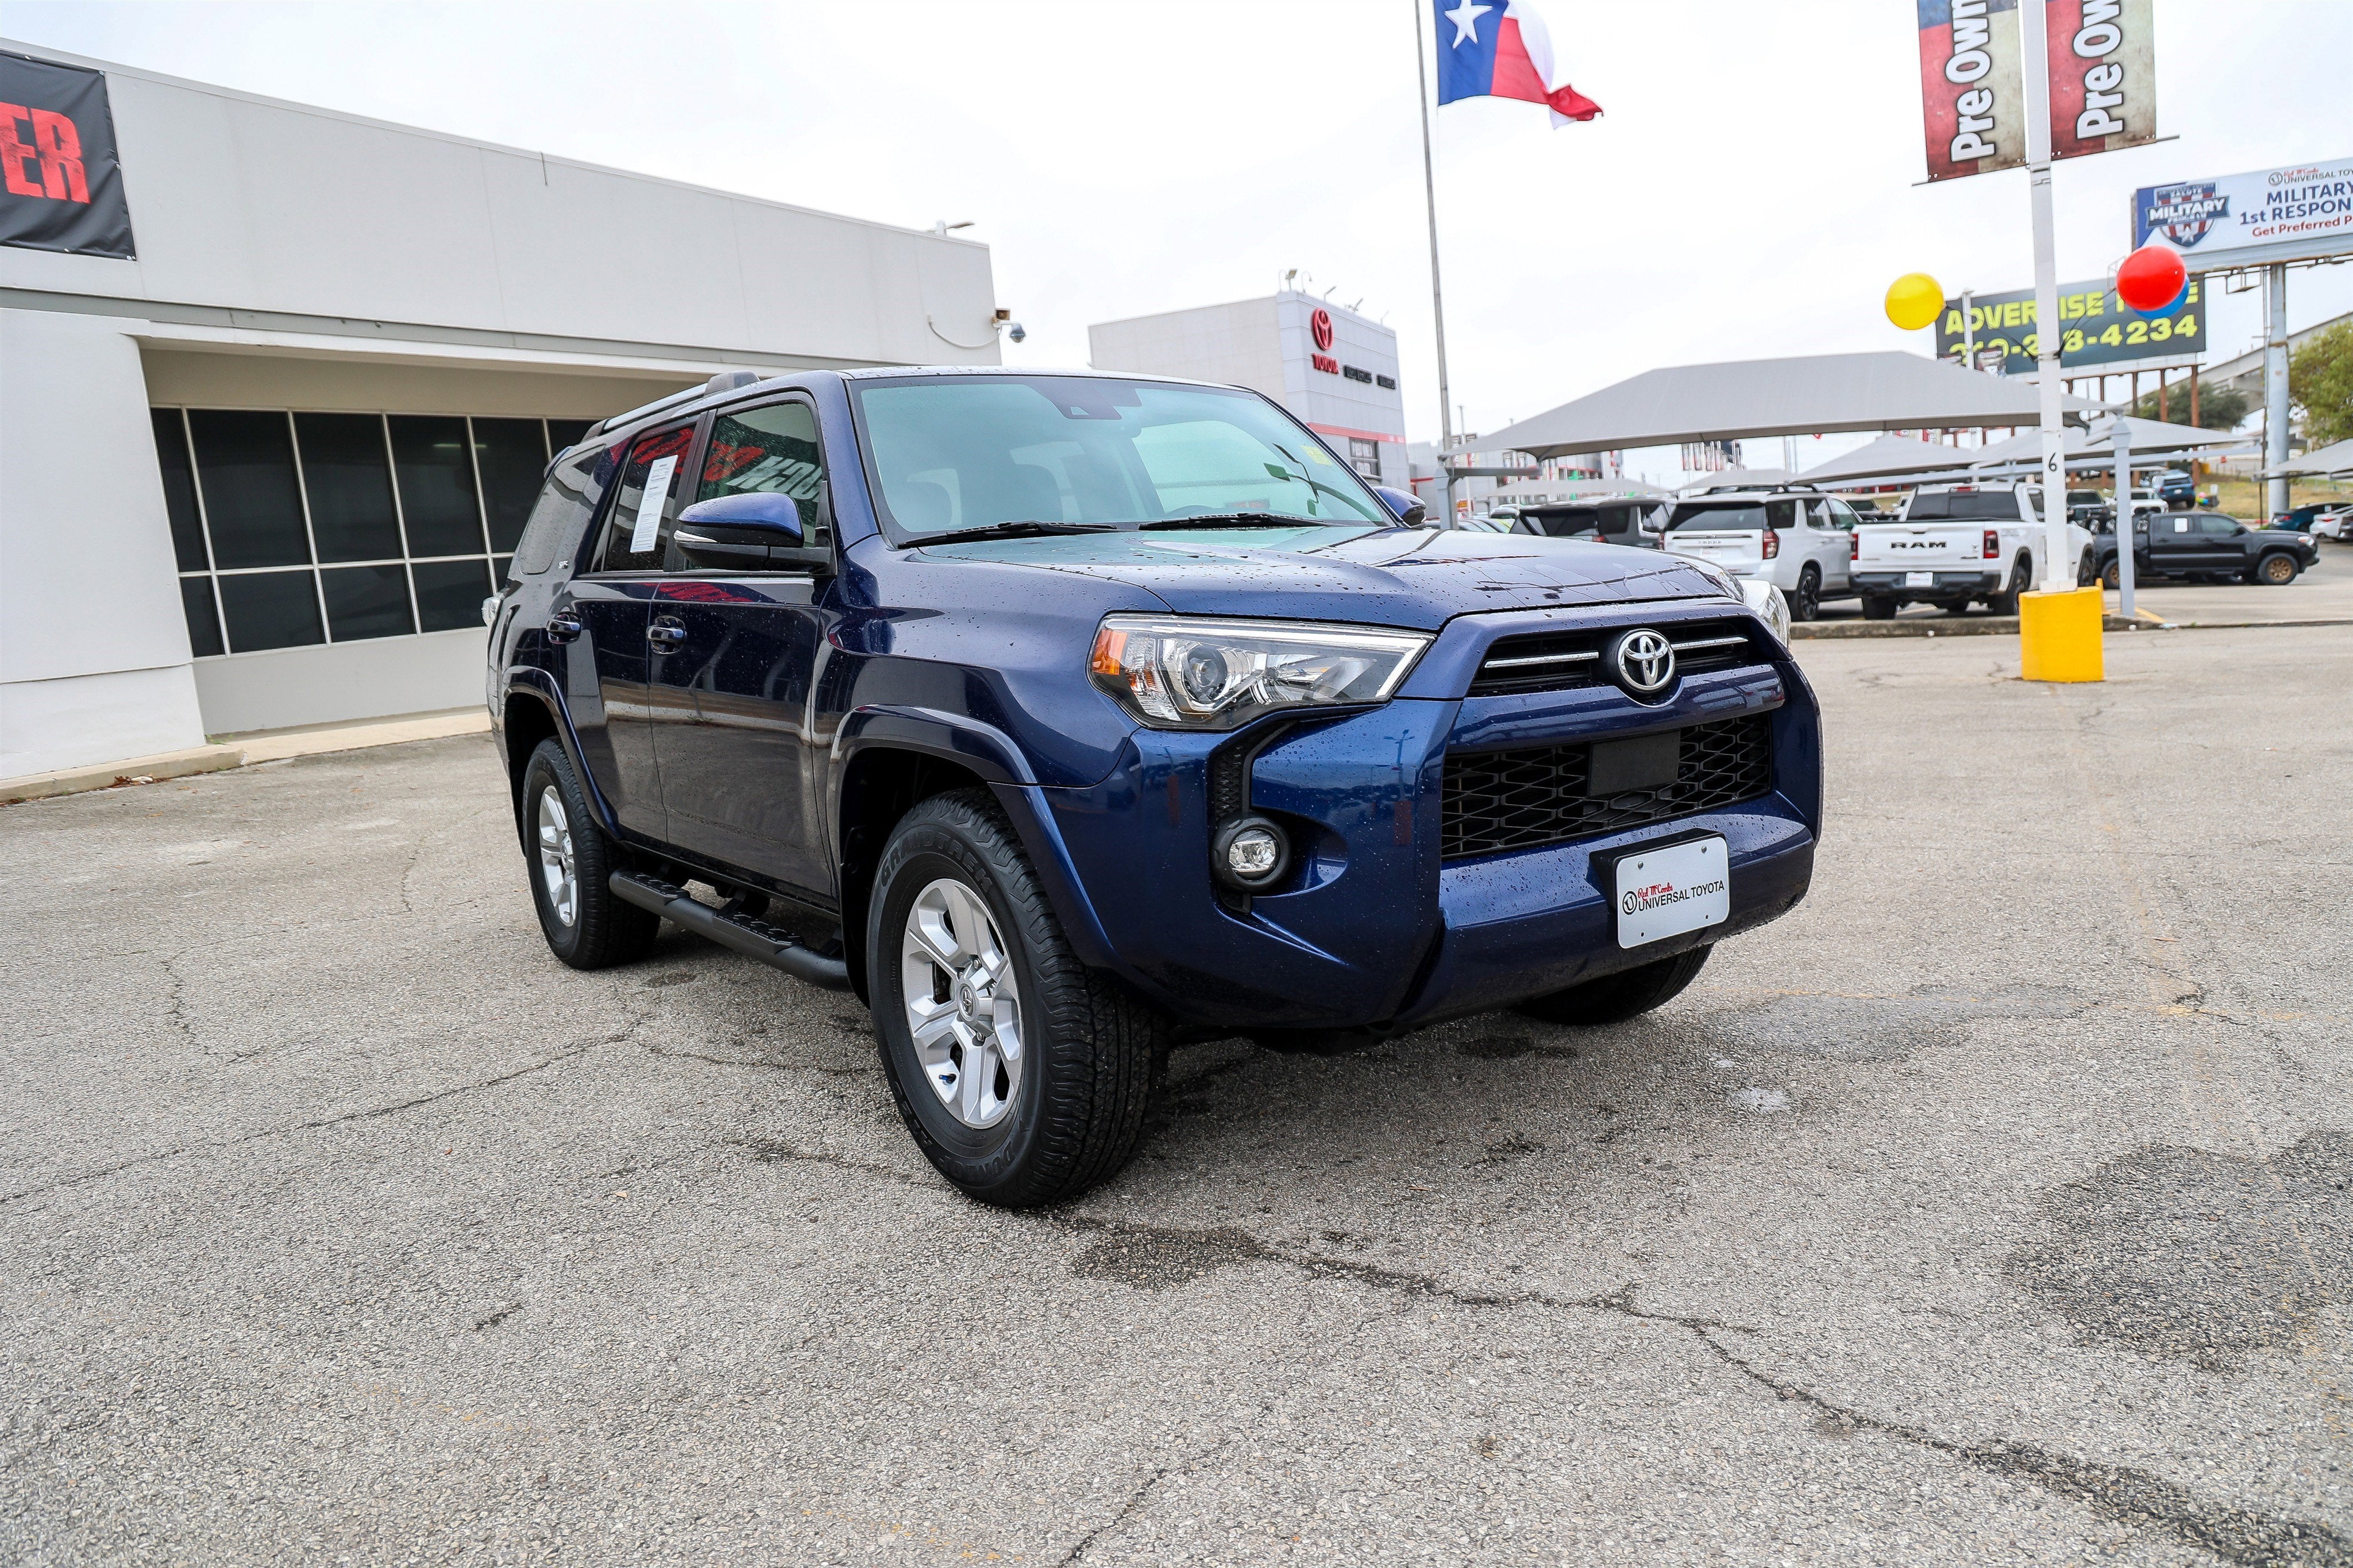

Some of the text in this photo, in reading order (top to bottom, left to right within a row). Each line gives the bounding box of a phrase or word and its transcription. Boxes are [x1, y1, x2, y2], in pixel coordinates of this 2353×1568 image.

[2077, 61, 2124, 139] Pre
[1950, 88, 1995, 162] Pre
[0, 101, 90, 203] ER
[2284, 171, 2336, 184] UNIVERSAL
[2266, 180, 2353, 206] MILITARY
[2149, 198, 2226, 221] MILITARY
[2240, 197, 2351, 225] 1st RESPON
[2252, 226, 2275, 237] Get
[2279, 216, 2340, 234] Preferred
[1945, 291, 2105, 335] ADVERISE
[2049, 452, 2057, 472] 6
[881, 831, 993, 893] GRANDTREK
[1638, 880, 1725, 912] UNIVERSAL TOYOTA
